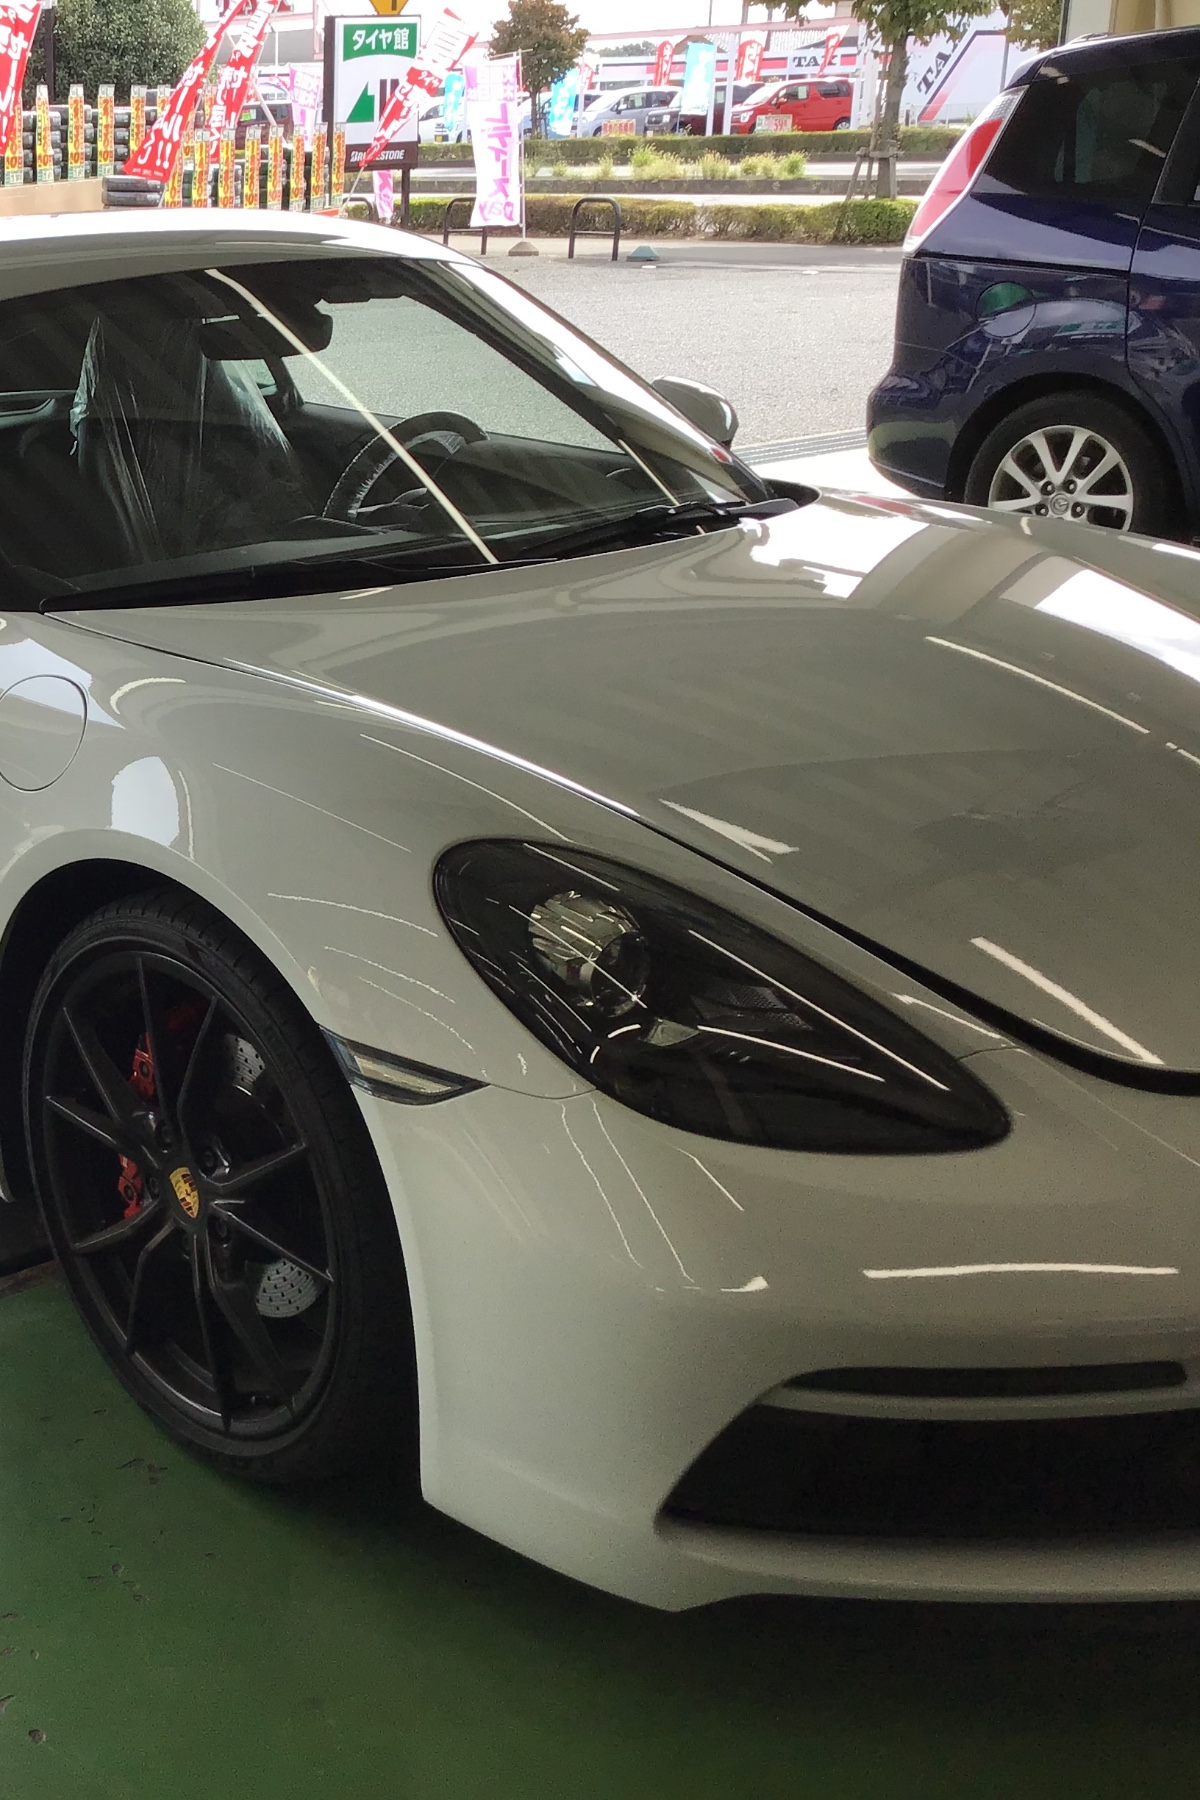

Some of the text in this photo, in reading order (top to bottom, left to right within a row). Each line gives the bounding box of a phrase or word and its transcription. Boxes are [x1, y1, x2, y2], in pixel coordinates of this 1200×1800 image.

[352, 27, 410, 51] タイヤ館
[417, 70, 442, 88] タイヤ
[350, 149, 405, 163] BRISTONE
